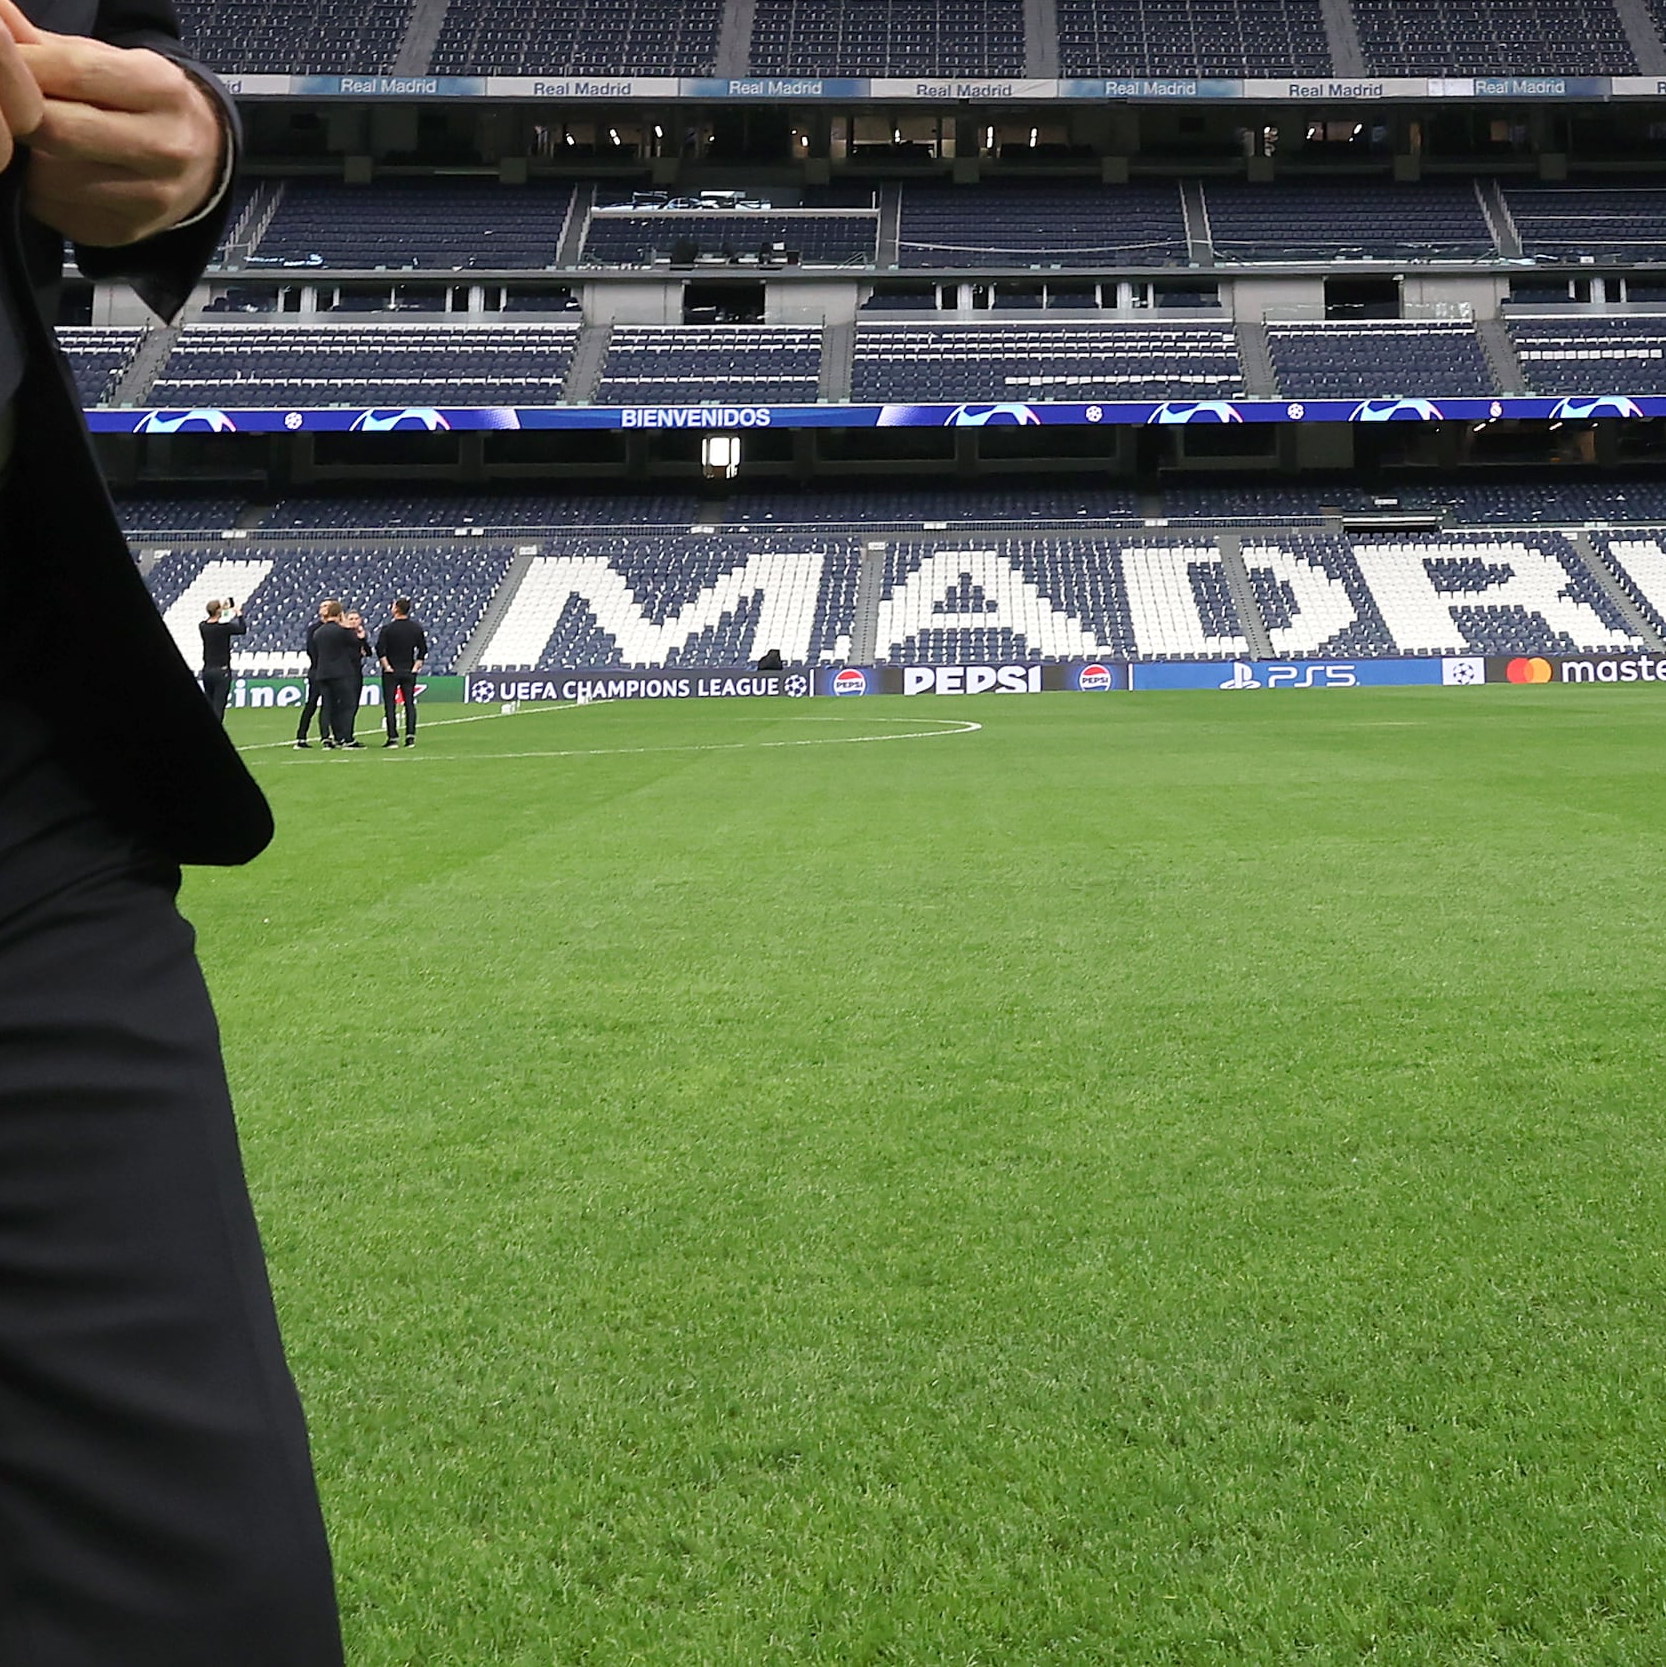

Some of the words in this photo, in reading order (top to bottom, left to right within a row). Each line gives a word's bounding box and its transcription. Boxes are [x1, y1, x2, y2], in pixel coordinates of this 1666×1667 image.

[340, 79, 377, 93] Real
[381, 79, 438, 93] Madrid
[534, 83, 569, 96] Real
[574, 82, 632, 96] Madrid
[729, 81, 763, 95] Real
[768, 81, 823, 95] Madrid
[917, 84, 951, 97] Real
[957, 84, 1013, 97] Madrid
[1105, 82, 1138, 95] Real
[1143, 82, 1197, 95] Madrid
[1289, 85, 1323, 97] Real
[1329, 84, 1383, 97] Madrid
[1476, 81, 1509, 94] Real
[1513, 81, 1566, 94] Madrid
[621, 408, 771, 427] BIENVENIDOS
[836, 681, 863, 689] PEPSI
[903, 665, 1041, 696] PEPSI
[1081, 677, 1109, 687] PEPSI
[500, 682, 558, 700] UEFA
[562, 679, 691, 700] CHAMPIONS
[697, 678, 780, 697] LEAGUE
